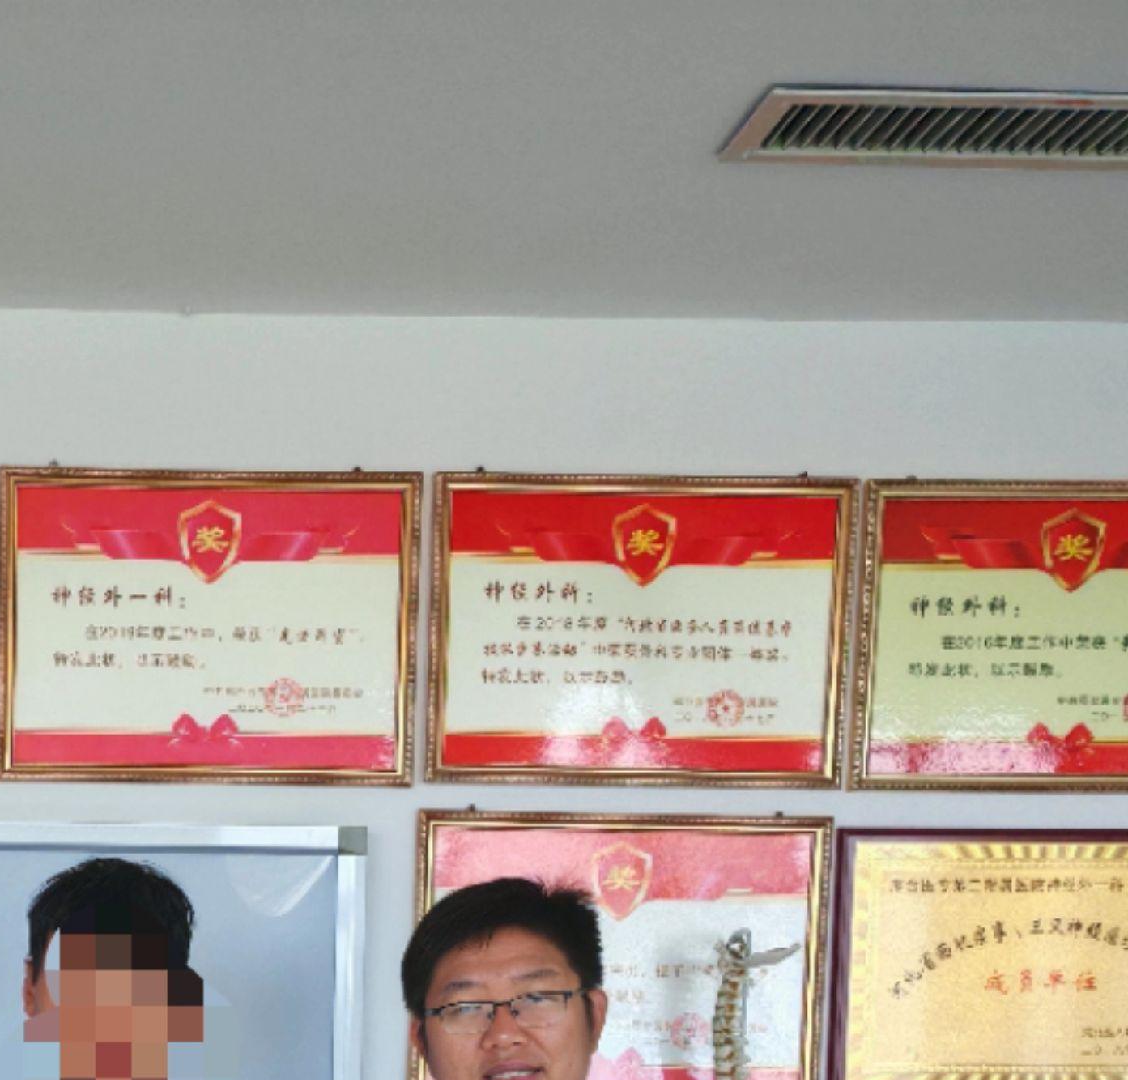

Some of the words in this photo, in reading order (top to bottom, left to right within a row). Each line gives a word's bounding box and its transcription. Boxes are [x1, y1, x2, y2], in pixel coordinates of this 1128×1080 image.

[192, 526, 229, 553] 奖
[626, 529, 664, 556] 奖
[1055, 534, 1093, 560] 奖
